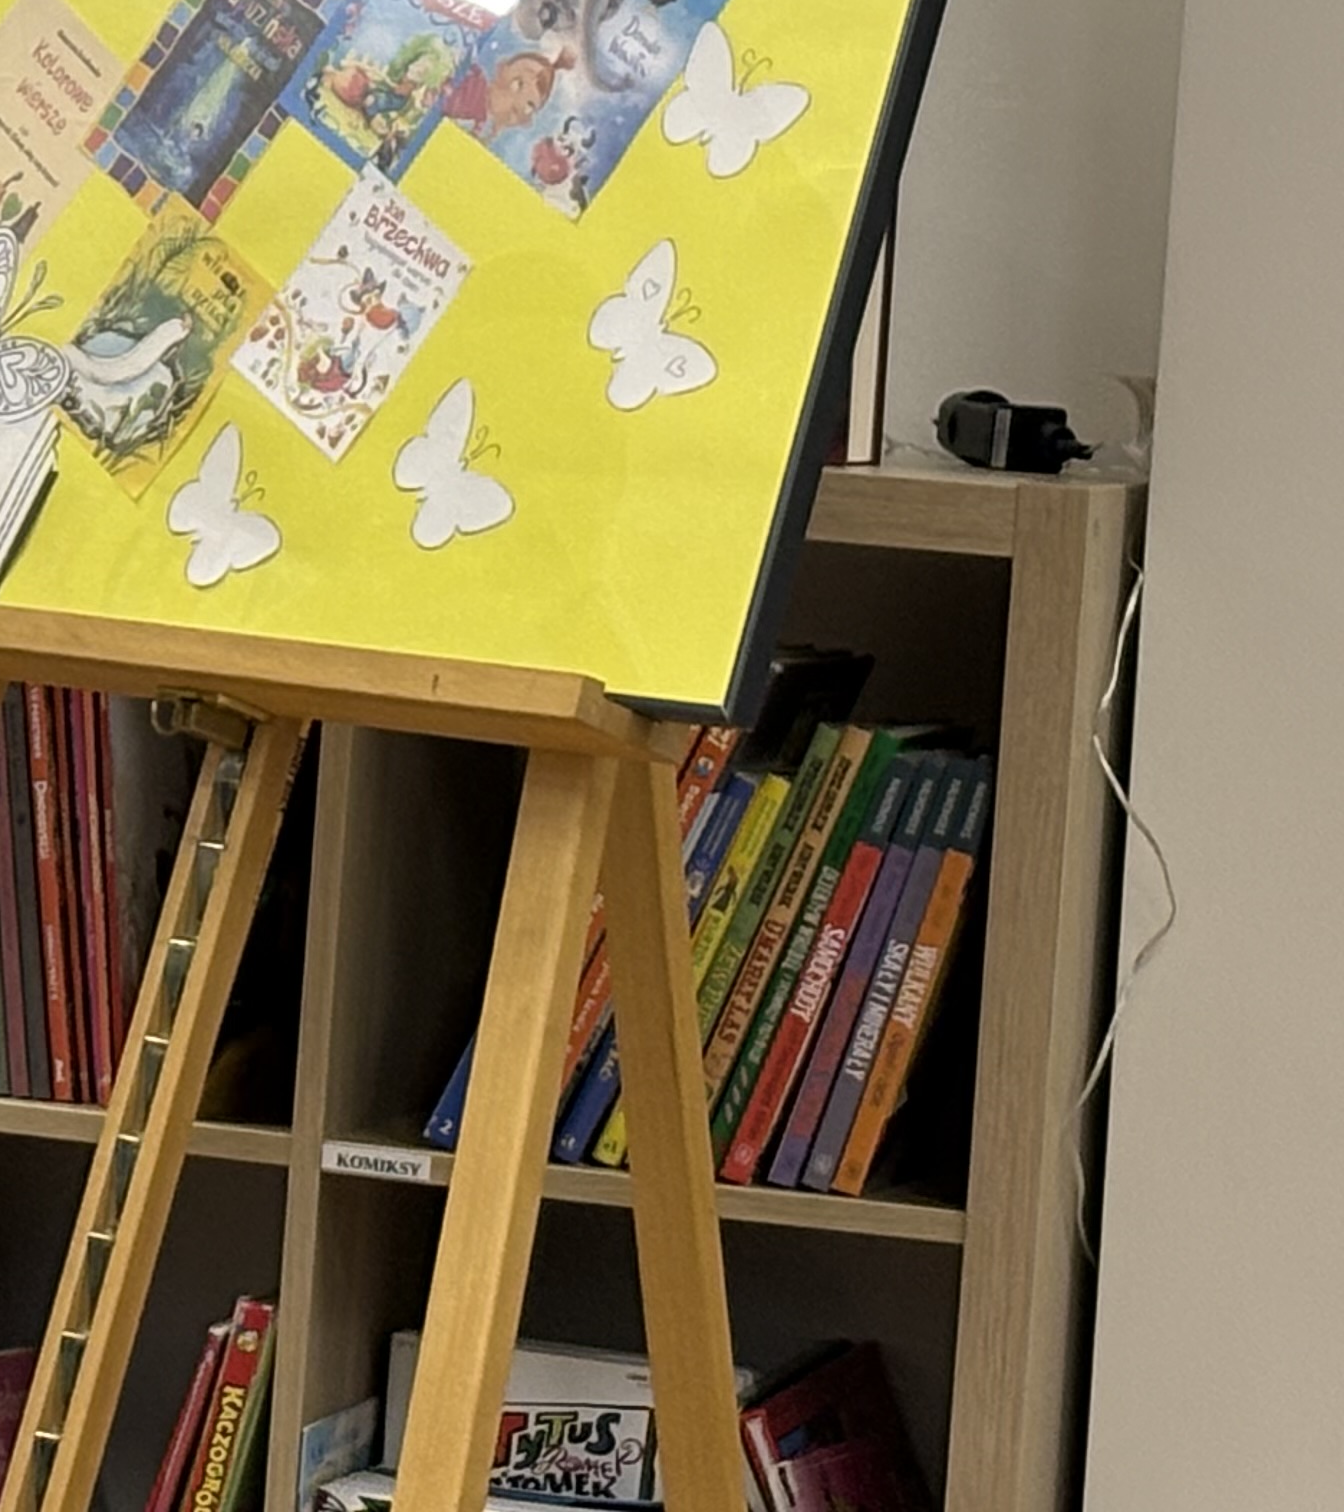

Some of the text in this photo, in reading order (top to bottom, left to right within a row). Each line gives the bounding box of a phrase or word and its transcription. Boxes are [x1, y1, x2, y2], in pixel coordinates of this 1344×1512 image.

[363, 204, 452, 280] Brzechwa
[336, 1150, 424, 1179] KOMIKSY
[493, 1411, 622, 1471] TYTUS
